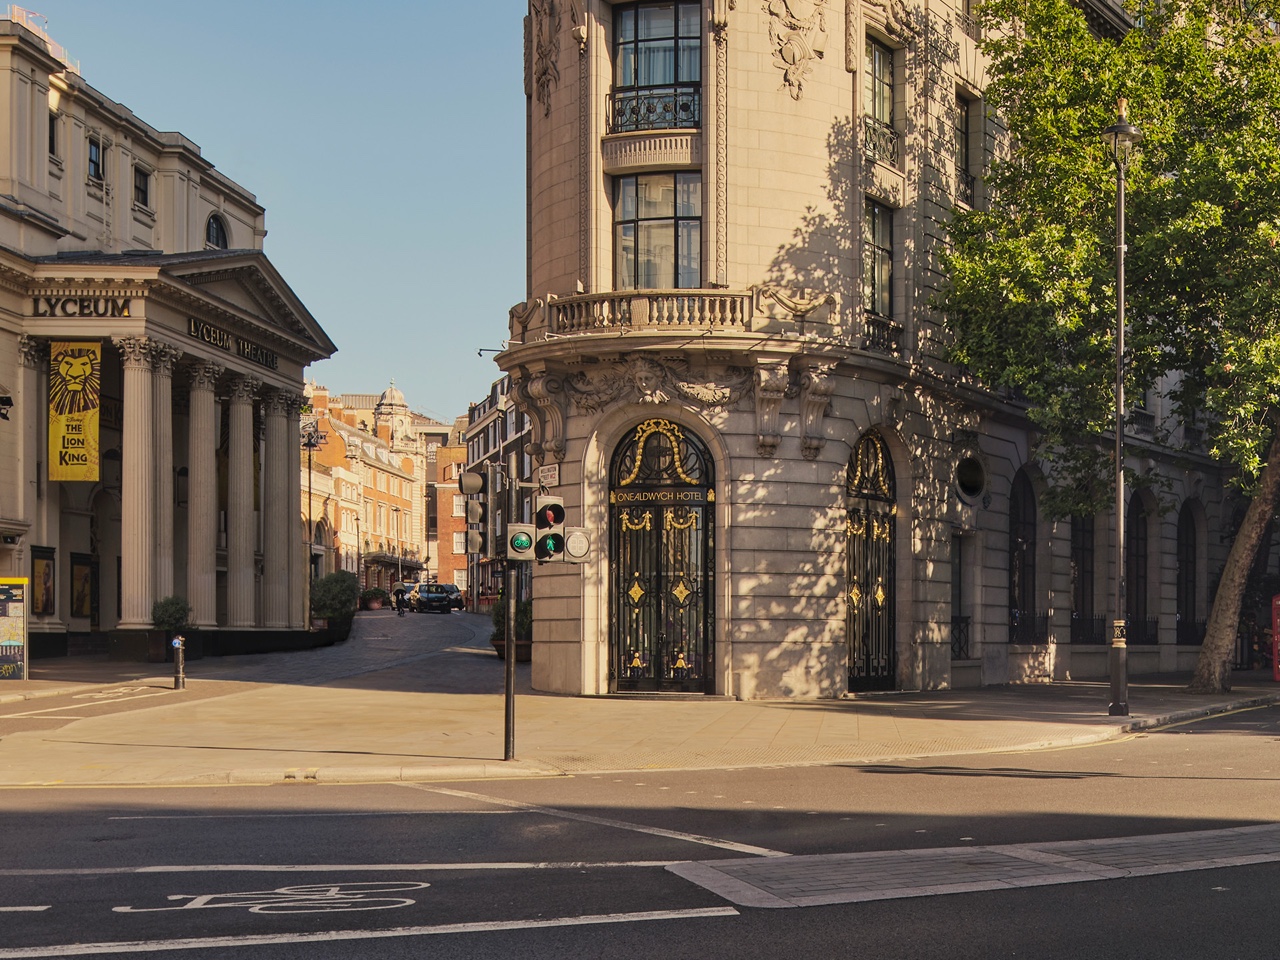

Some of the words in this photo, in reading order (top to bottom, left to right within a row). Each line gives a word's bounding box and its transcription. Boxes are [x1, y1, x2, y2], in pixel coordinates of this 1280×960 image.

[32, 297, 131, 318] LYCEUM
[187, 318, 232, 351] LYCEUM
[237, 339, 279, 370] THEATRE
[65, 424, 83, 432] THE
[676, 491, 704, 501] HOTEL
